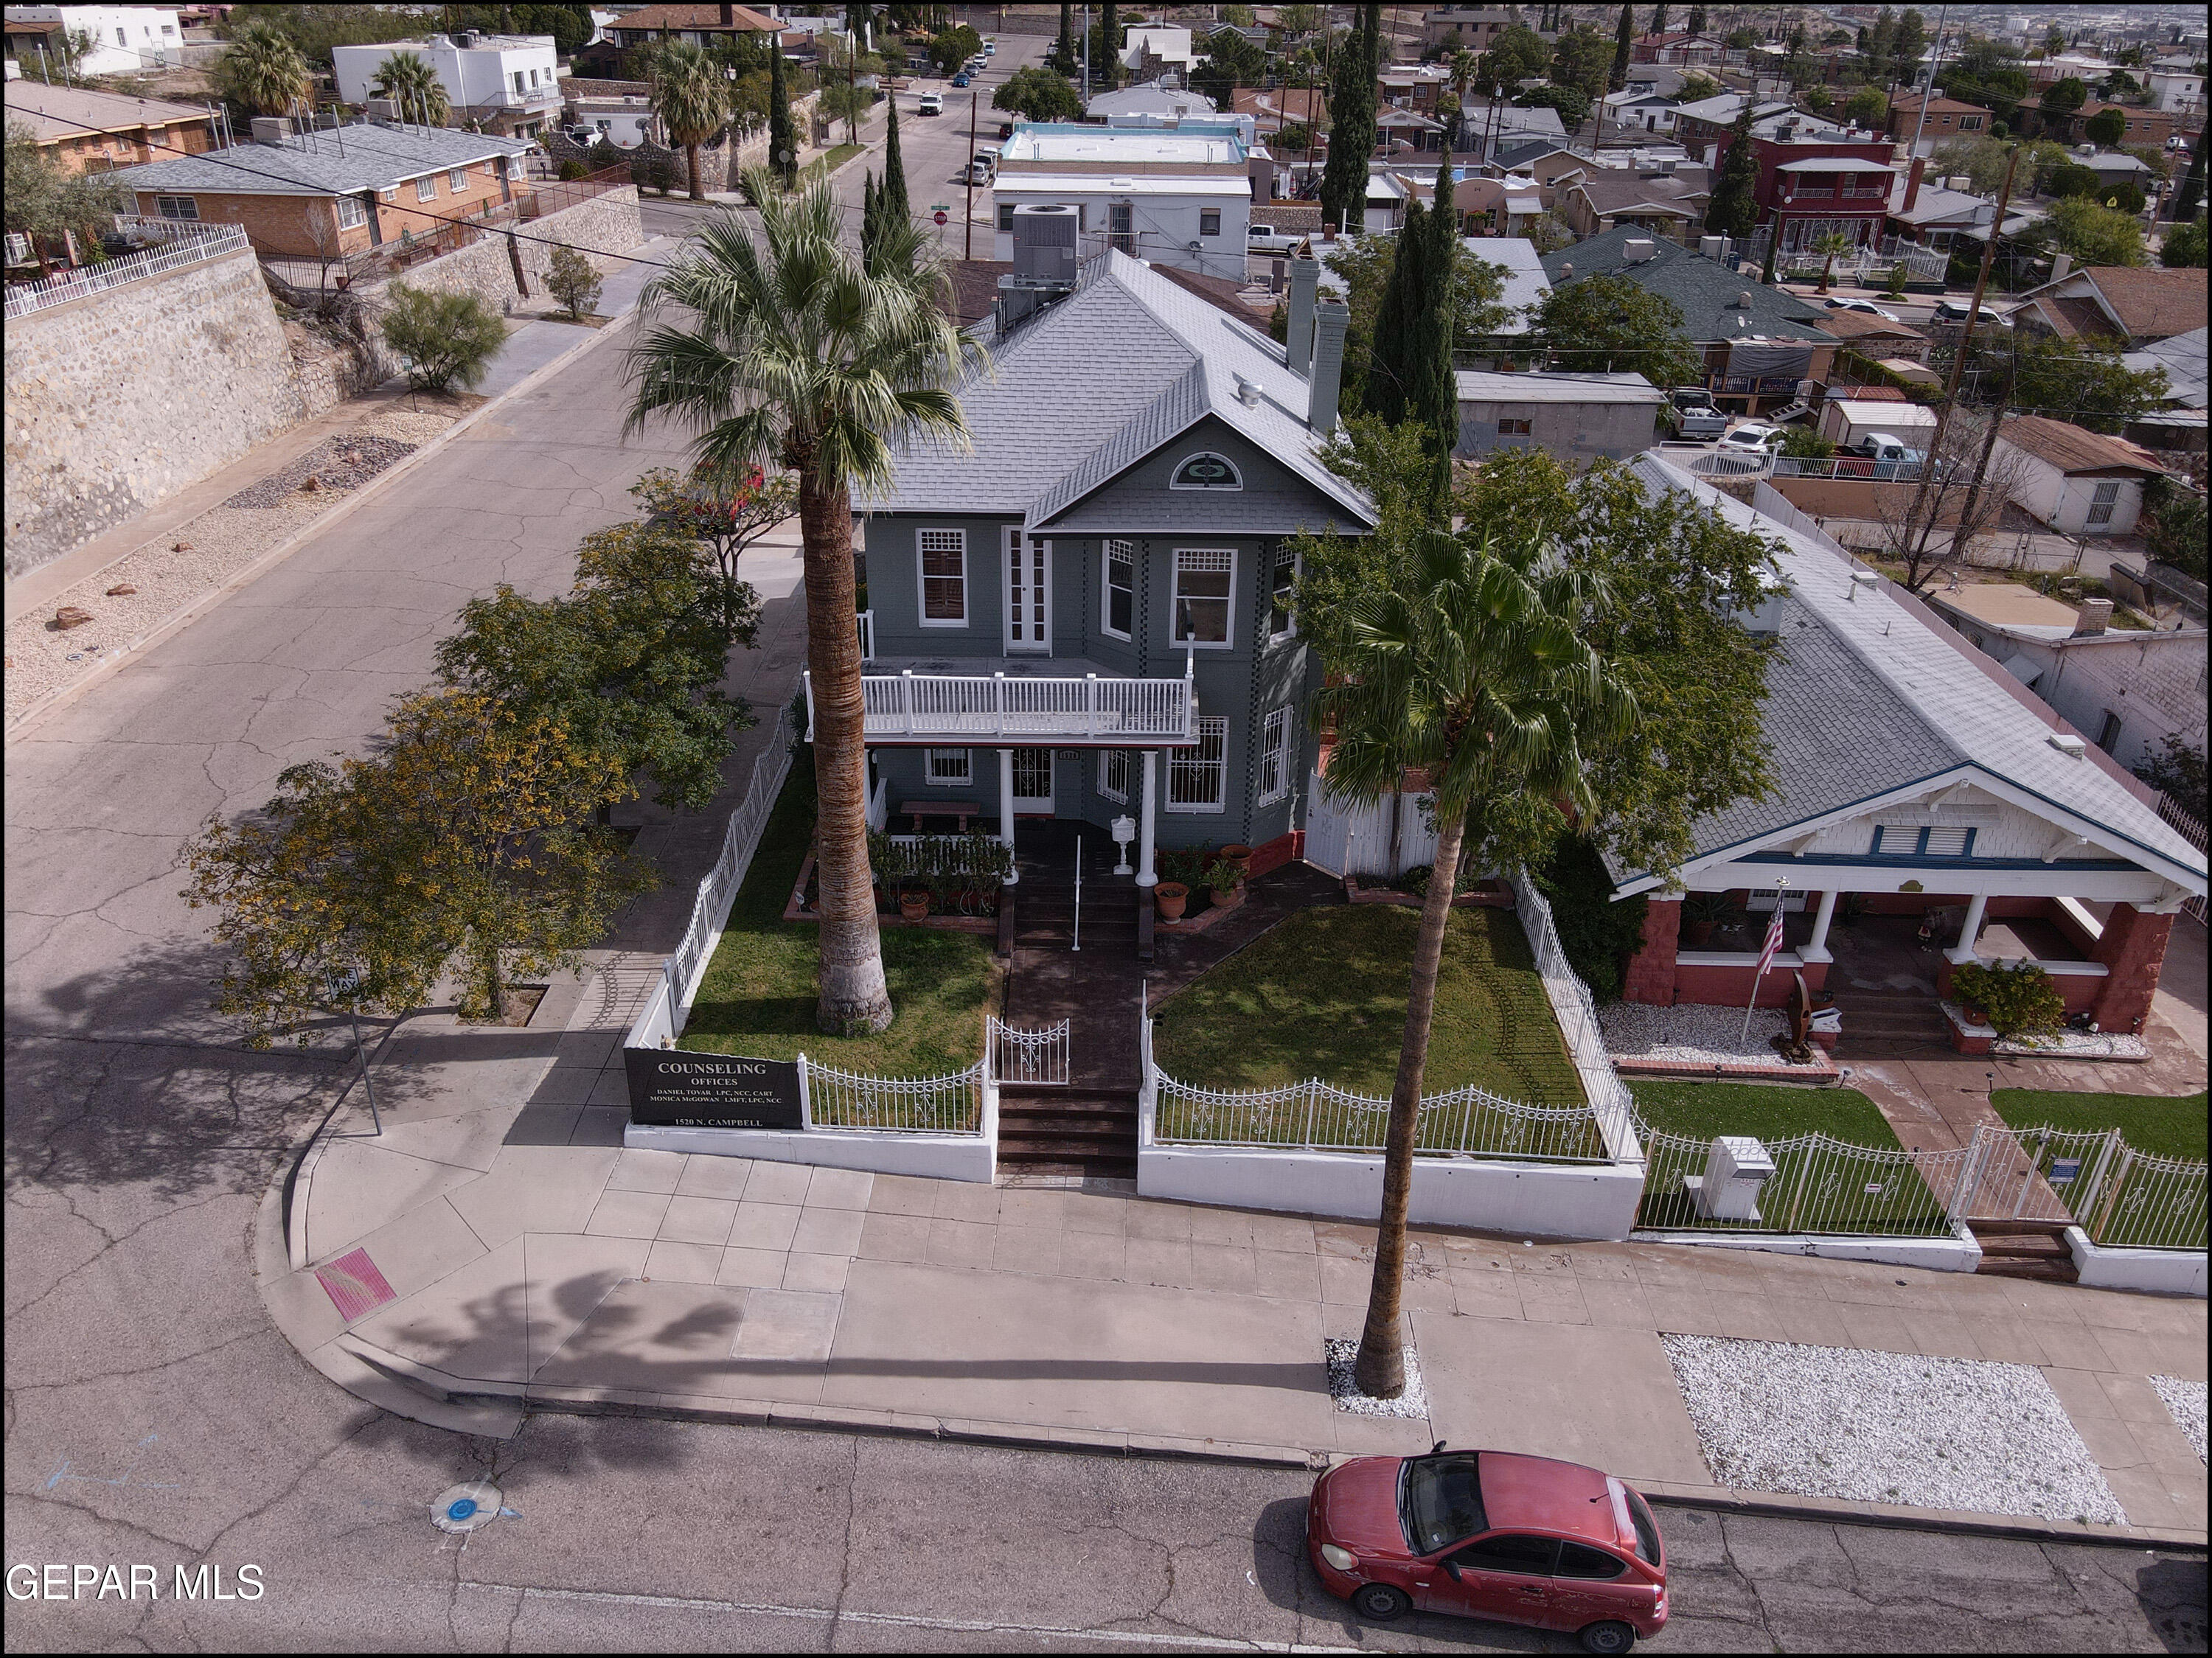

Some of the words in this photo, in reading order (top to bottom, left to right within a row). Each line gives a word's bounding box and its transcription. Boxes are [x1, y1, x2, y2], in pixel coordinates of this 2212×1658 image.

[331, 979, 355, 989] WAY
[658, 1062, 767, 1075] COUNSELING
[691, 1078, 738, 1086] OFFICES
[708, 1119, 763, 1127] CAMPBELL
